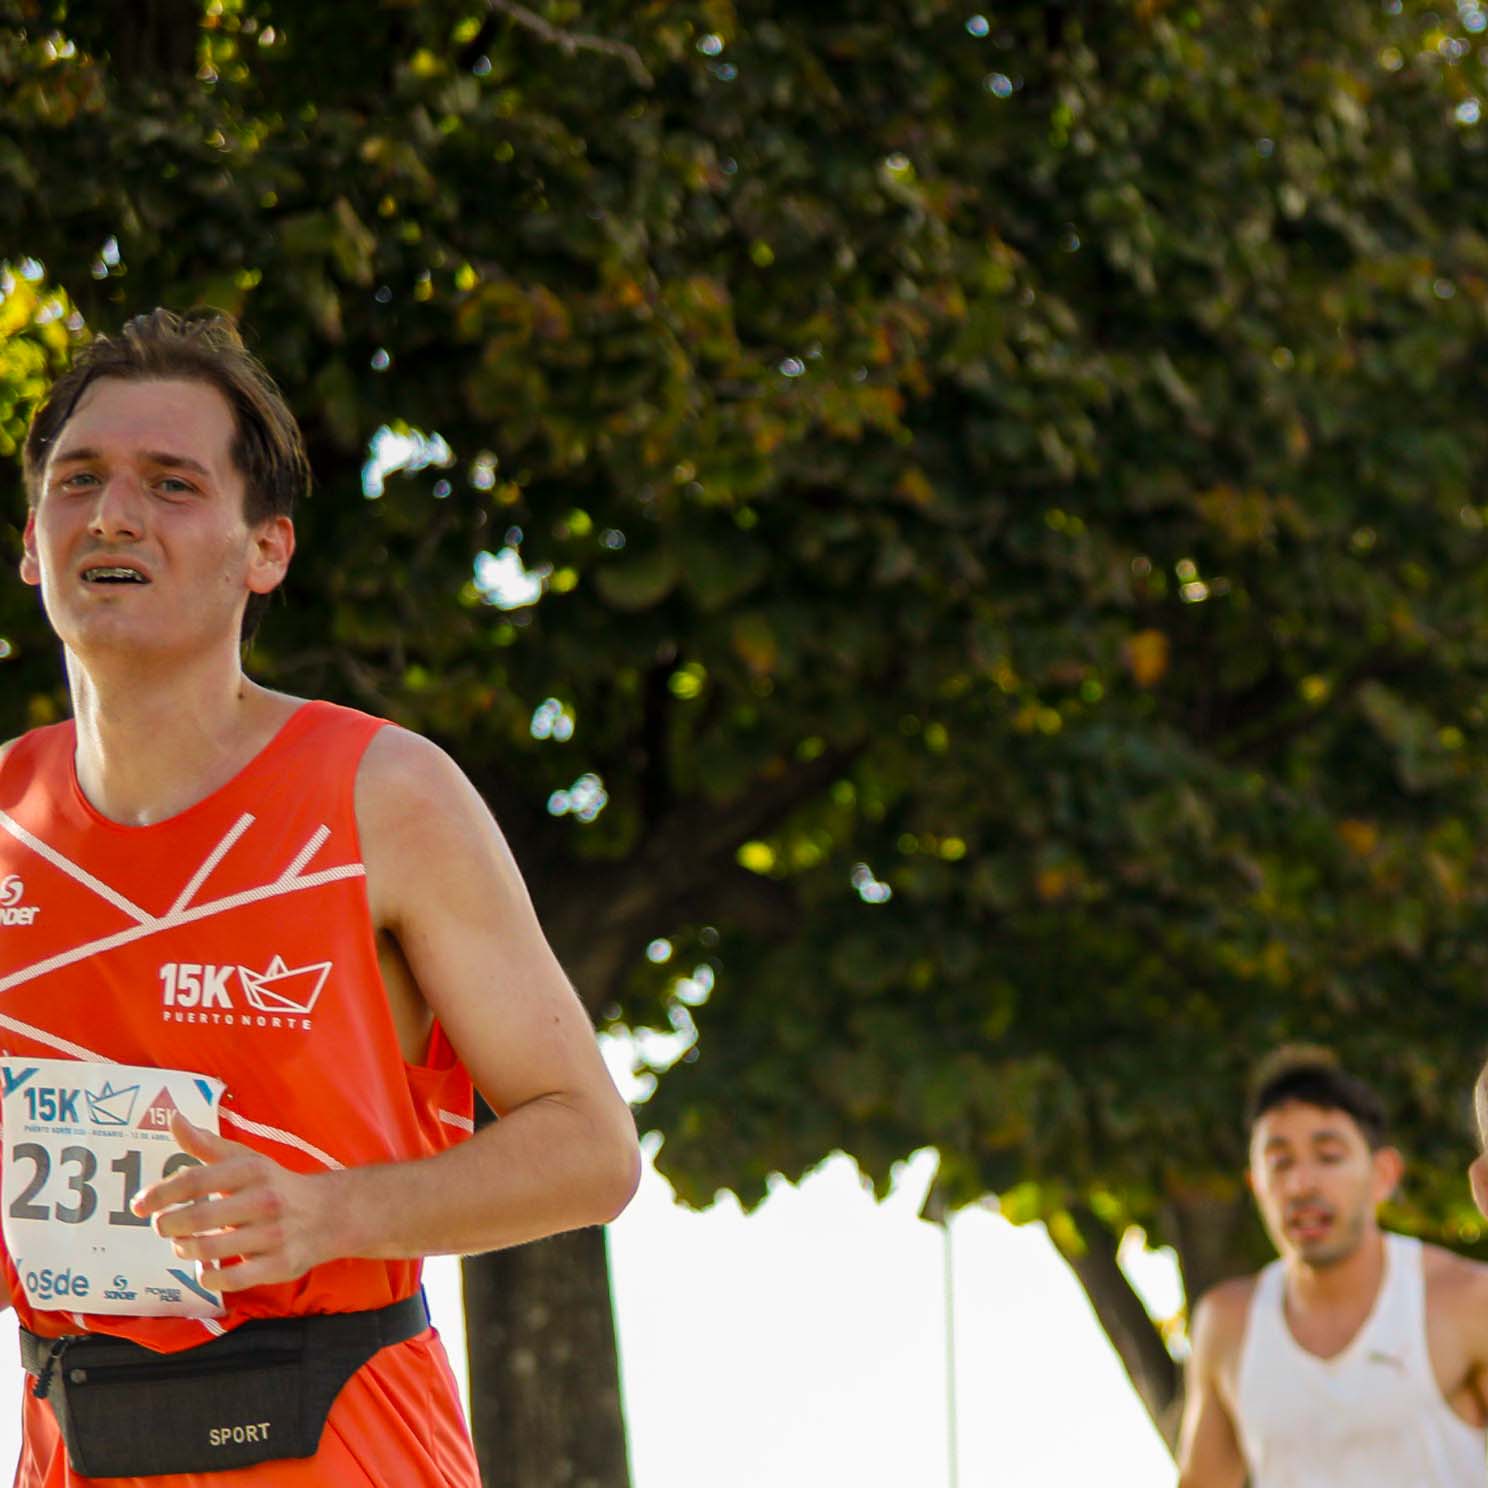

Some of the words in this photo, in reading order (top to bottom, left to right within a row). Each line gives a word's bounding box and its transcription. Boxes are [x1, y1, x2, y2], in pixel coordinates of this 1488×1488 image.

[160, 962, 236, 1009] 15K
[162, 1011, 234, 1025] PUERTO
[240, 1015, 312, 1030] NORTE
[24, 1087, 81, 1123] 15K
[9, 1142, 205, 1227] 231
[26, 1268, 89, 1299] osde
[209, 1422, 271, 1446] SPORT
